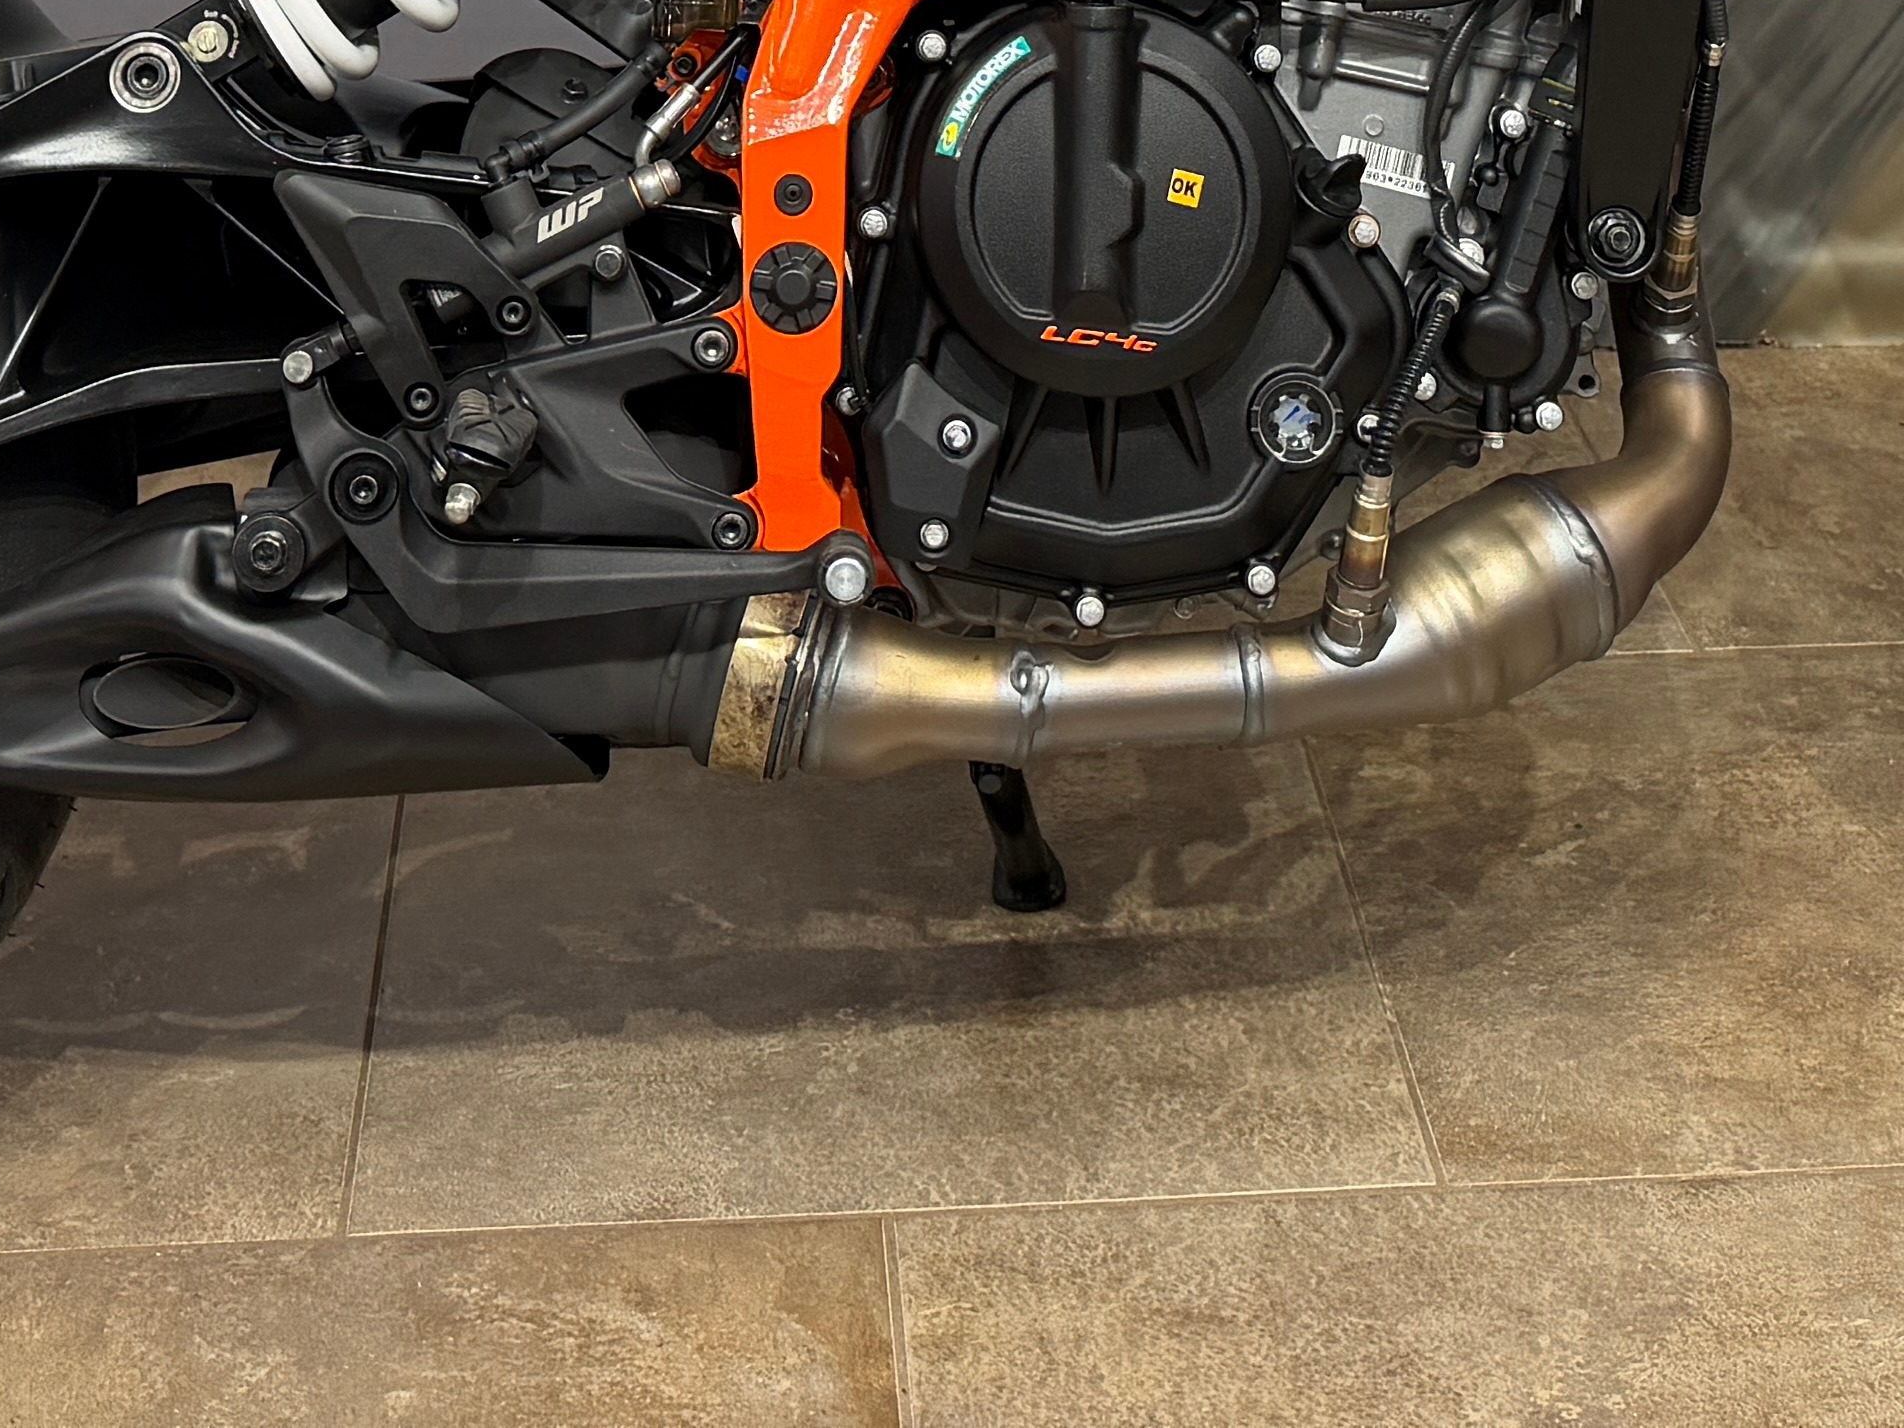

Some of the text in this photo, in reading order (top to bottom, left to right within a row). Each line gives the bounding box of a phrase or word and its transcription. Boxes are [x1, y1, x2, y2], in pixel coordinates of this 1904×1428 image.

[951, 37, 1027, 123] MOTOREX
[537, 186, 605, 243] WP
[1171, 177, 1197, 199] OK
